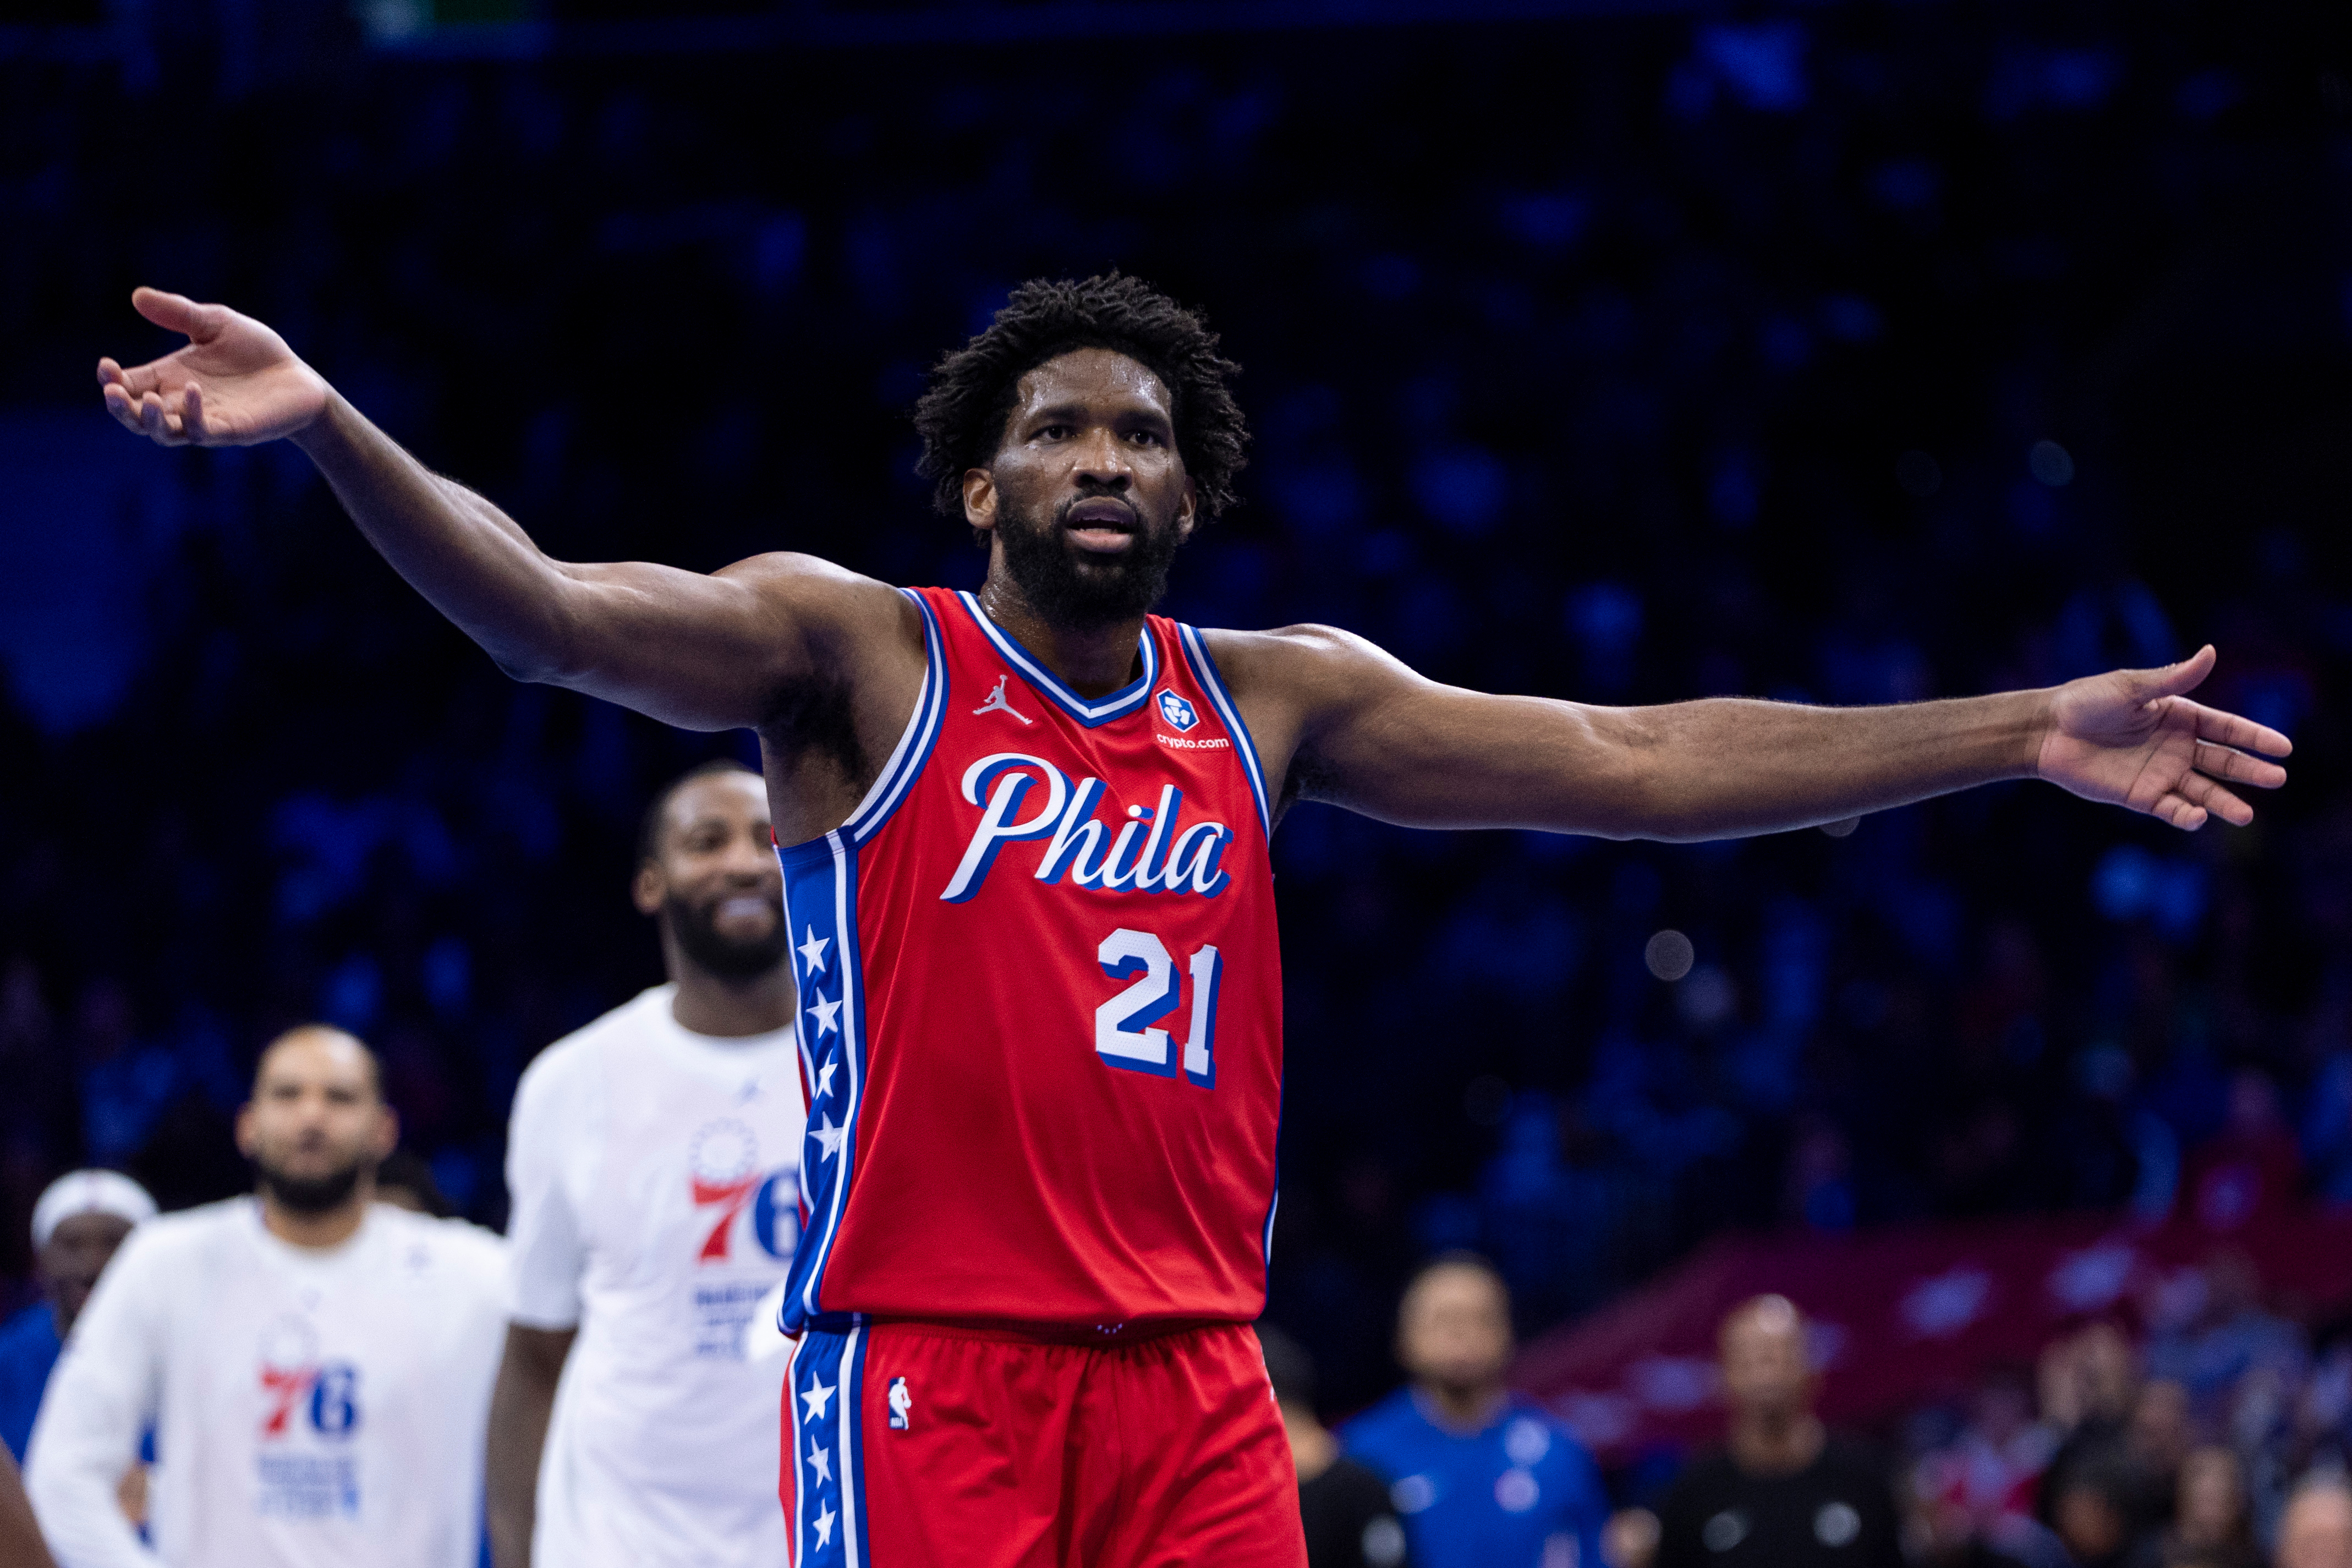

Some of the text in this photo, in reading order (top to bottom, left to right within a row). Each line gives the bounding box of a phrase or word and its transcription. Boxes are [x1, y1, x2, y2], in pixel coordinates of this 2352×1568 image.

[1156, 733, 1230, 748] crypto.com
[939, 752, 1233, 904] Phila
[1095, 928, 1224, 1090] 21
[690, 1162, 803, 1263] 76
[257, 1360, 362, 1441] 76
